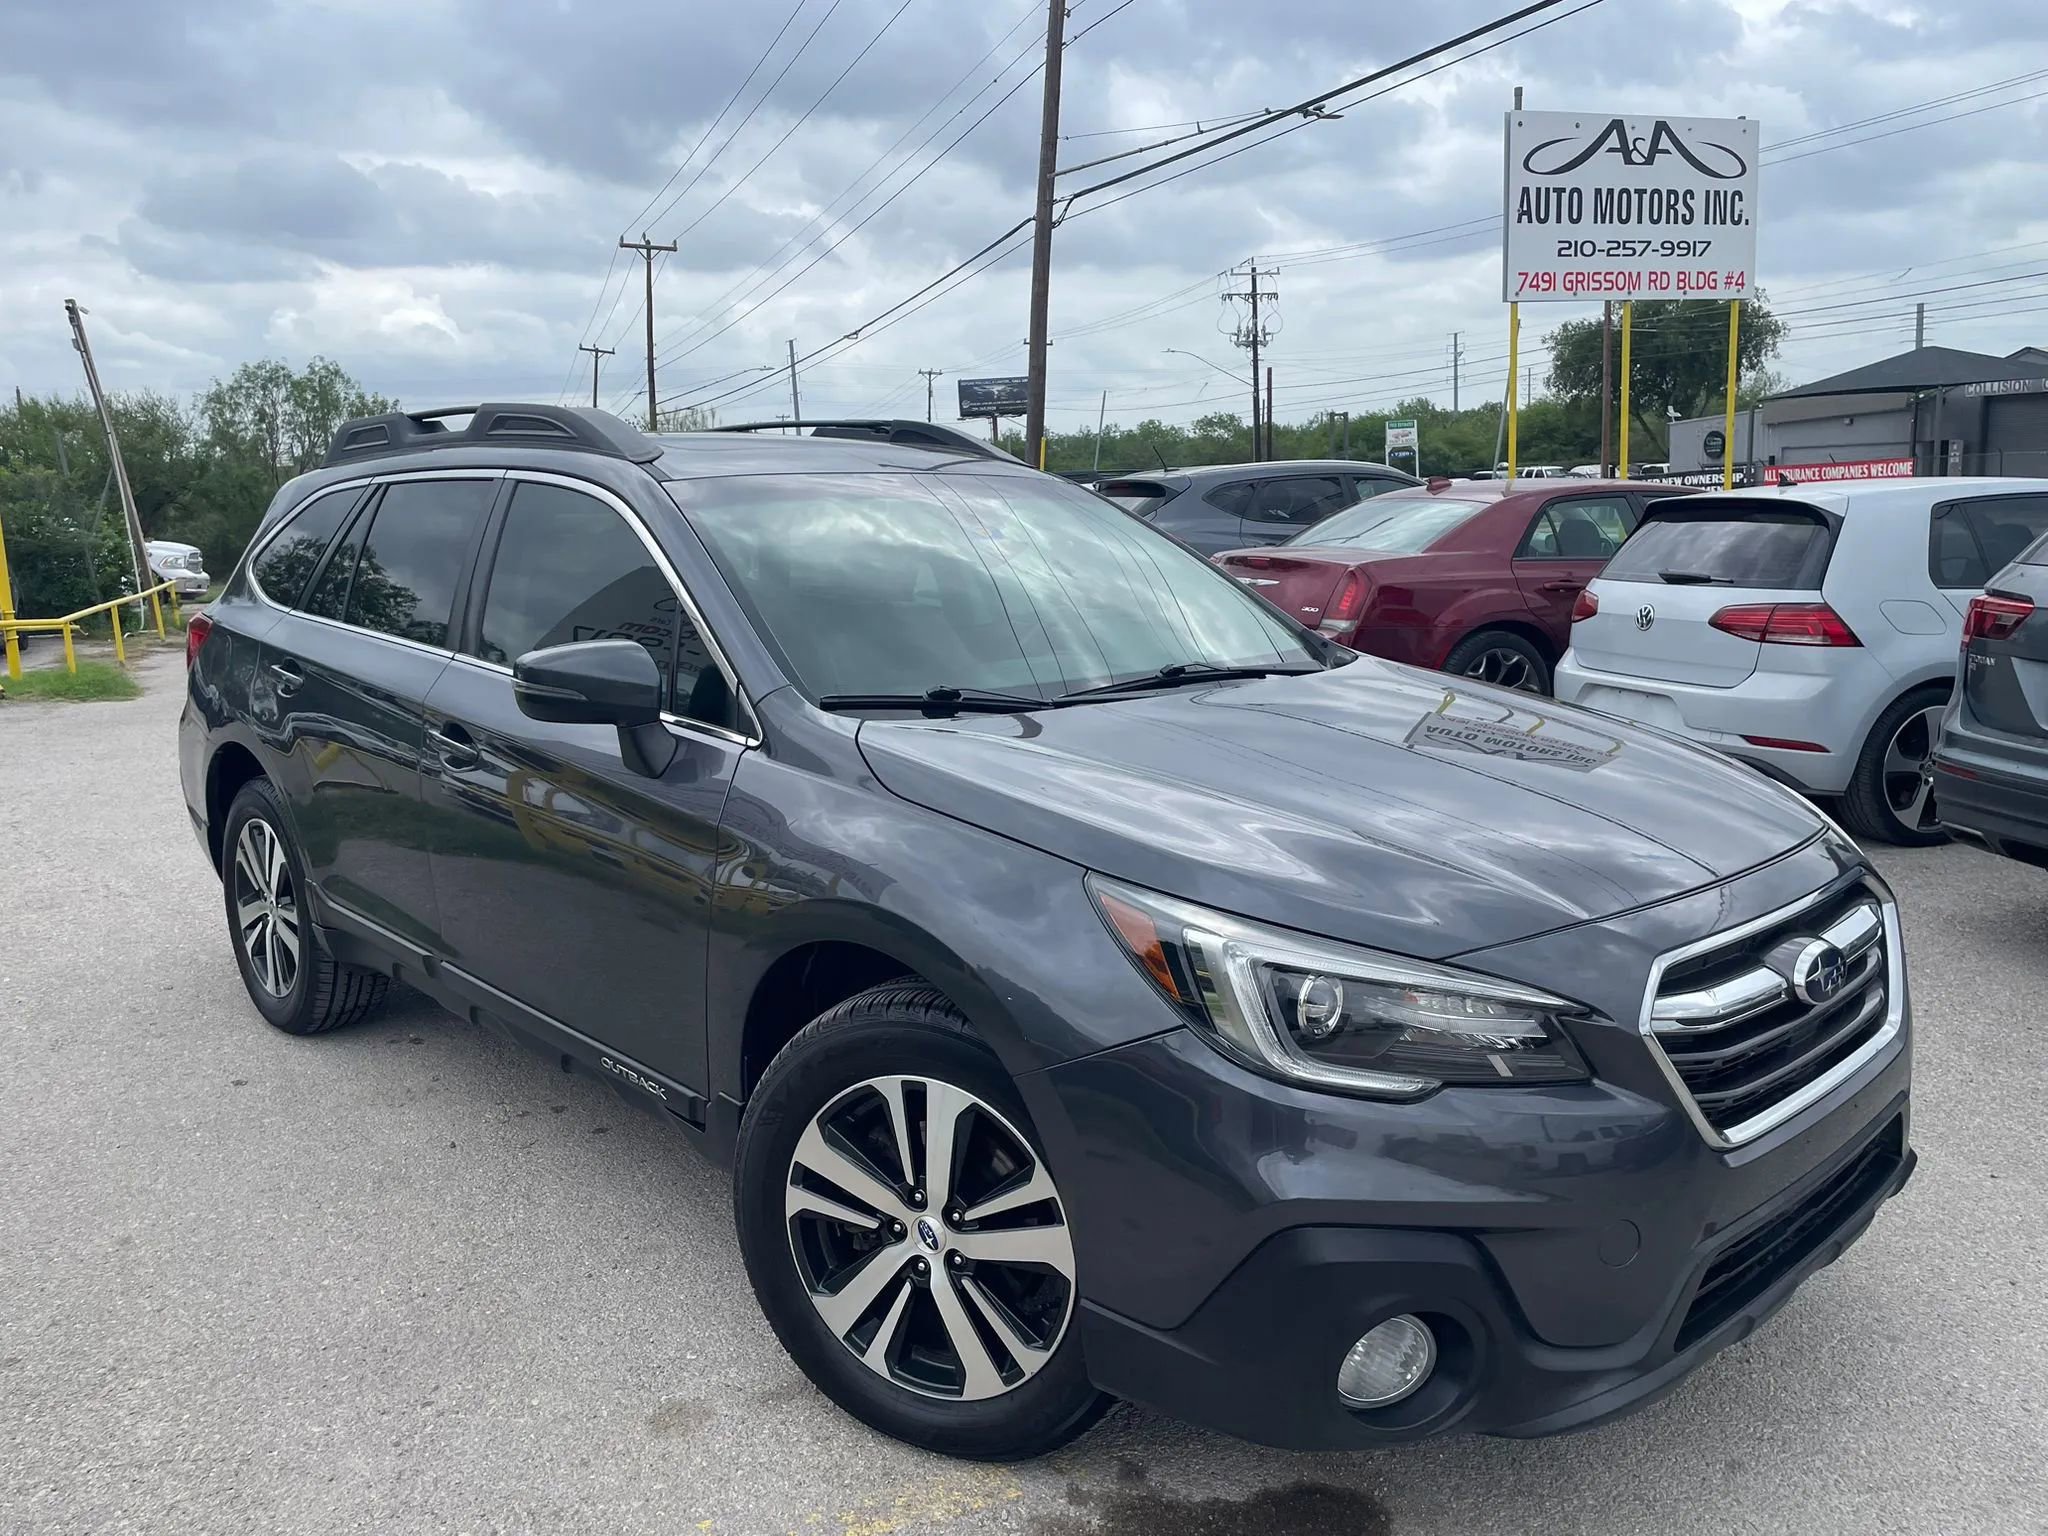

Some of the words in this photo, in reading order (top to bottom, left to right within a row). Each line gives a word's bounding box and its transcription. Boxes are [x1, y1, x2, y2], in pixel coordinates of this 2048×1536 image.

[1517, 187, 1583, 224] AUTO
[1593, 188, 1695, 225] MOTORS
[1704, 190, 1749, 226] INC.
[1557, 240, 1712, 257] 210-257-9917
[1518, 272, 1556, 292] 7491
[1563, 271, 1641, 291] GRISSOM
[1648, 271, 1670, 290] RD
[1677, 271, 1717, 290] BLDG
[1724, 271, 1745, 290] #4
[1965, 380, 2031, 396] COLLISION
[1764, 470, 1777, 481] ALL
[1821, 464, 1869, 480] COMPANIES
[1870, 461, 1913, 477] WELCOME
[600, 1056, 667, 1100] OUTBACK
